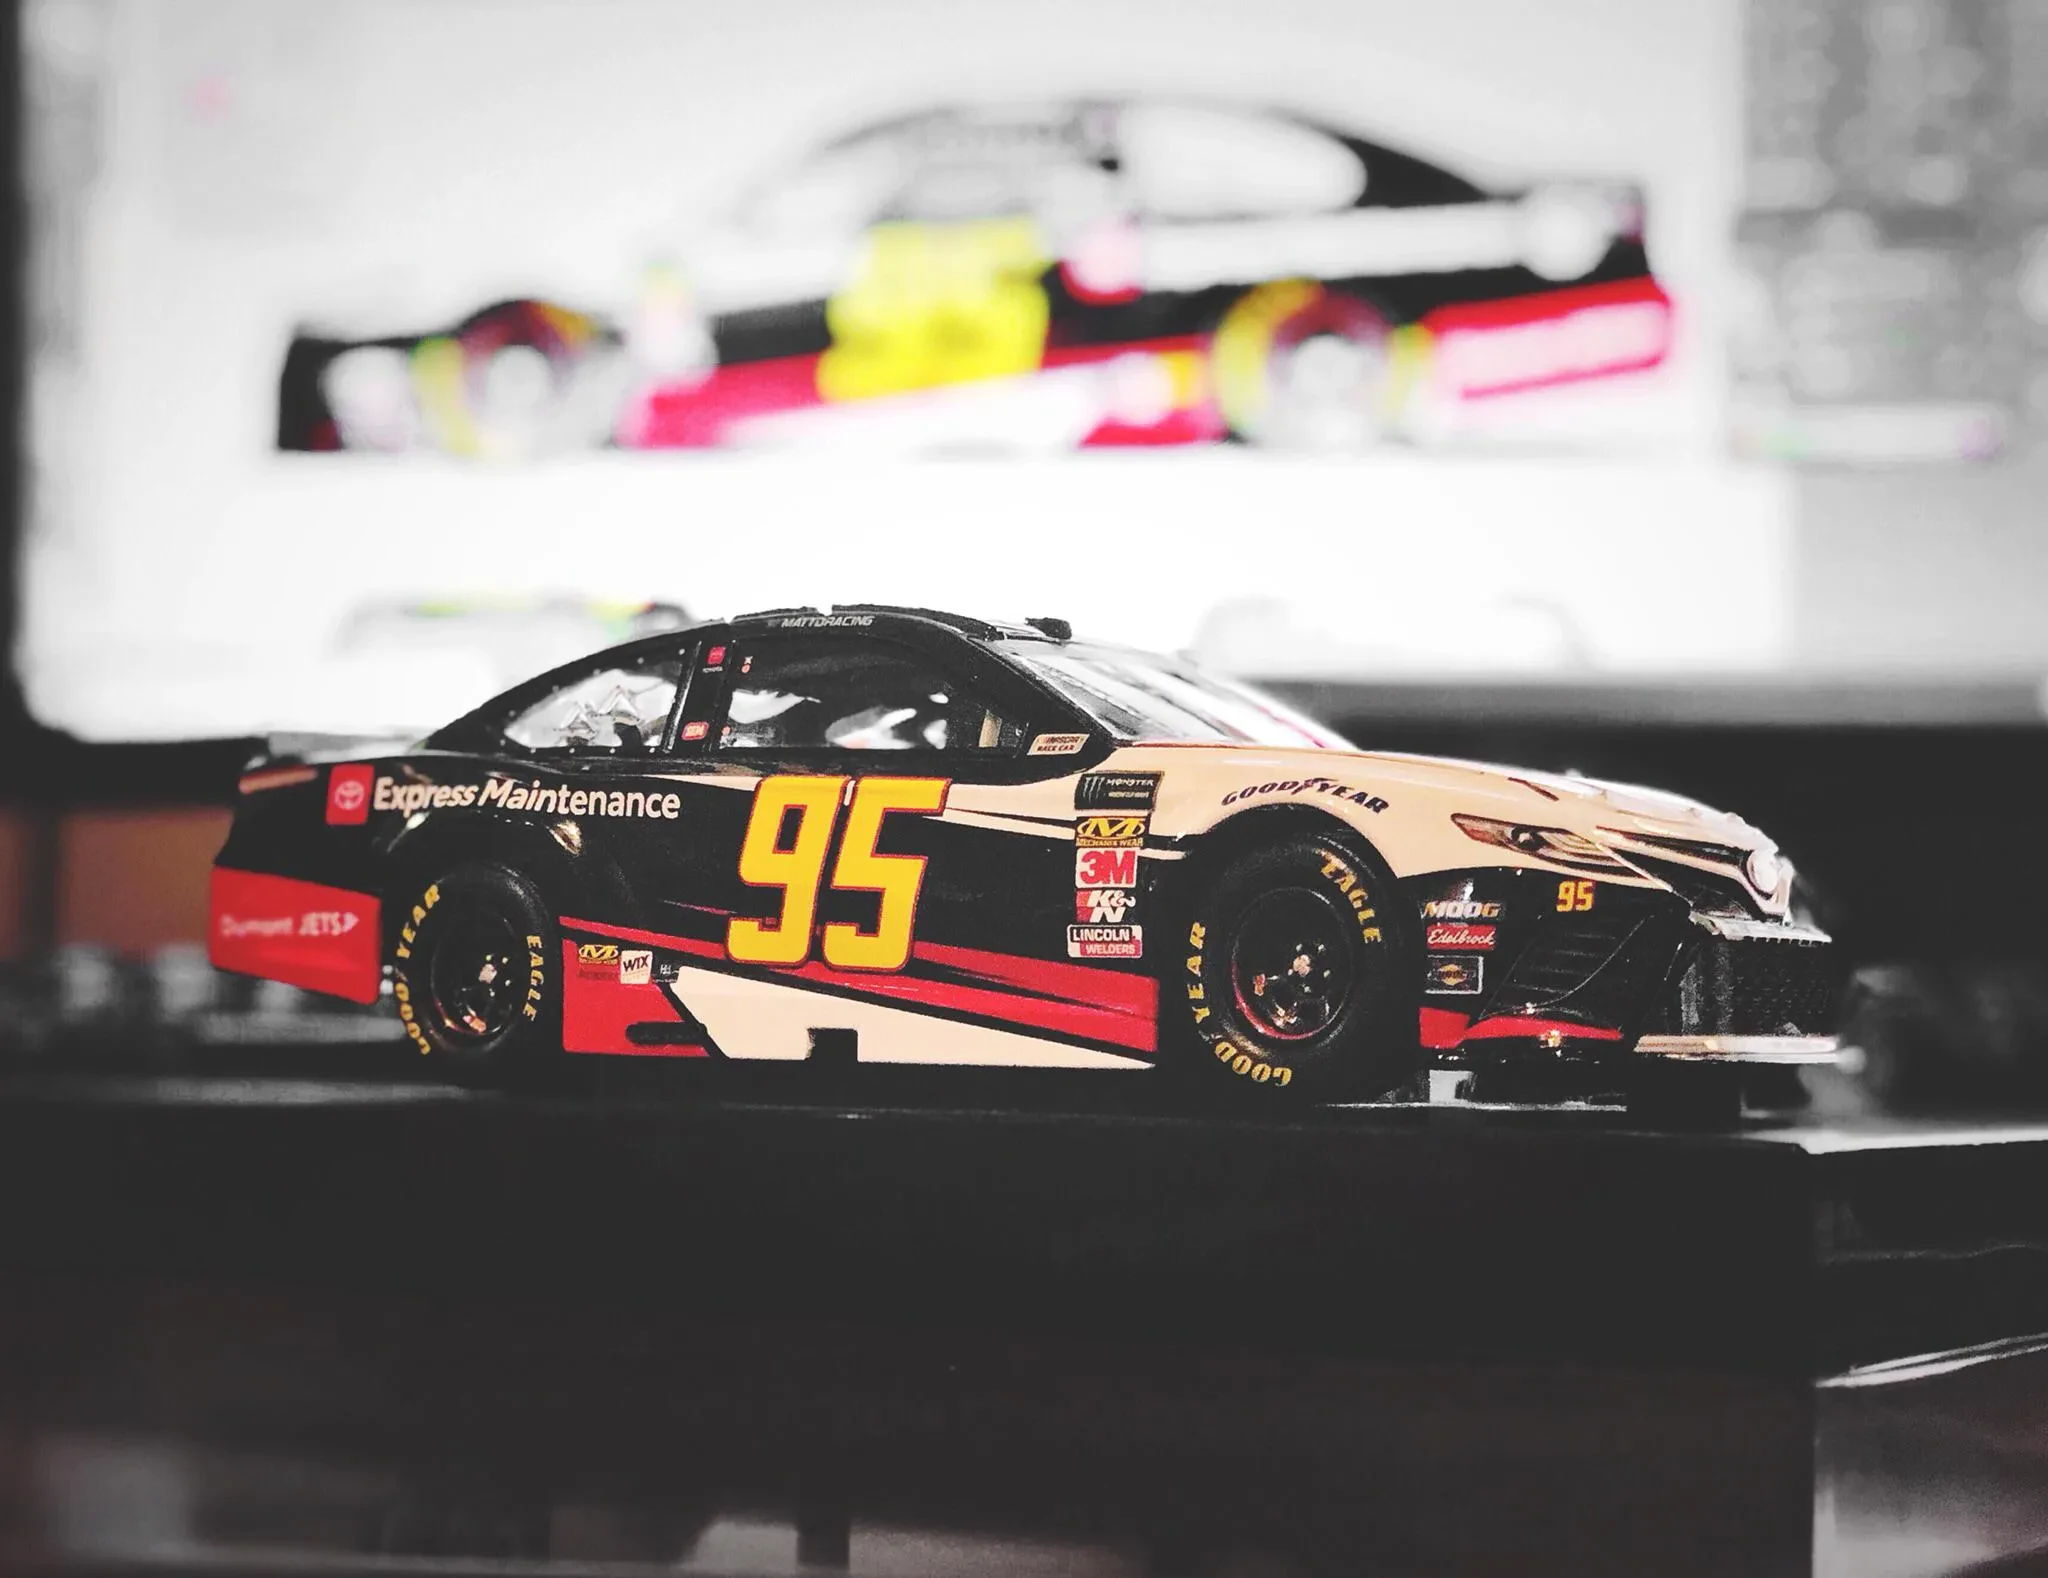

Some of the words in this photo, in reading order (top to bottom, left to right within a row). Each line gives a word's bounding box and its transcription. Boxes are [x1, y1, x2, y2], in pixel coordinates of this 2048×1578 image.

[1106, 778, 1154, 786] MONSTER
[373, 777, 478, 817] Express
[478, 780, 681, 819] Maintenance
[725, 774, 953, 975] 95
[1080, 850, 1136, 884] 3M
[1320, 860, 1382, 944] EAGLE
[1556, 880, 1594, 912] 95
[1424, 901, 1501, 919] MOOG
[299, 912, 342, 936] JETS
[1073, 928, 1130, 941] LINCOLN
[1086, 944, 1136, 955] WELDERS
[1428, 929, 1495, 946] Edelbrock
[623, 955, 650, 973] WIX
[523, 935, 545, 1022] EAGLE
